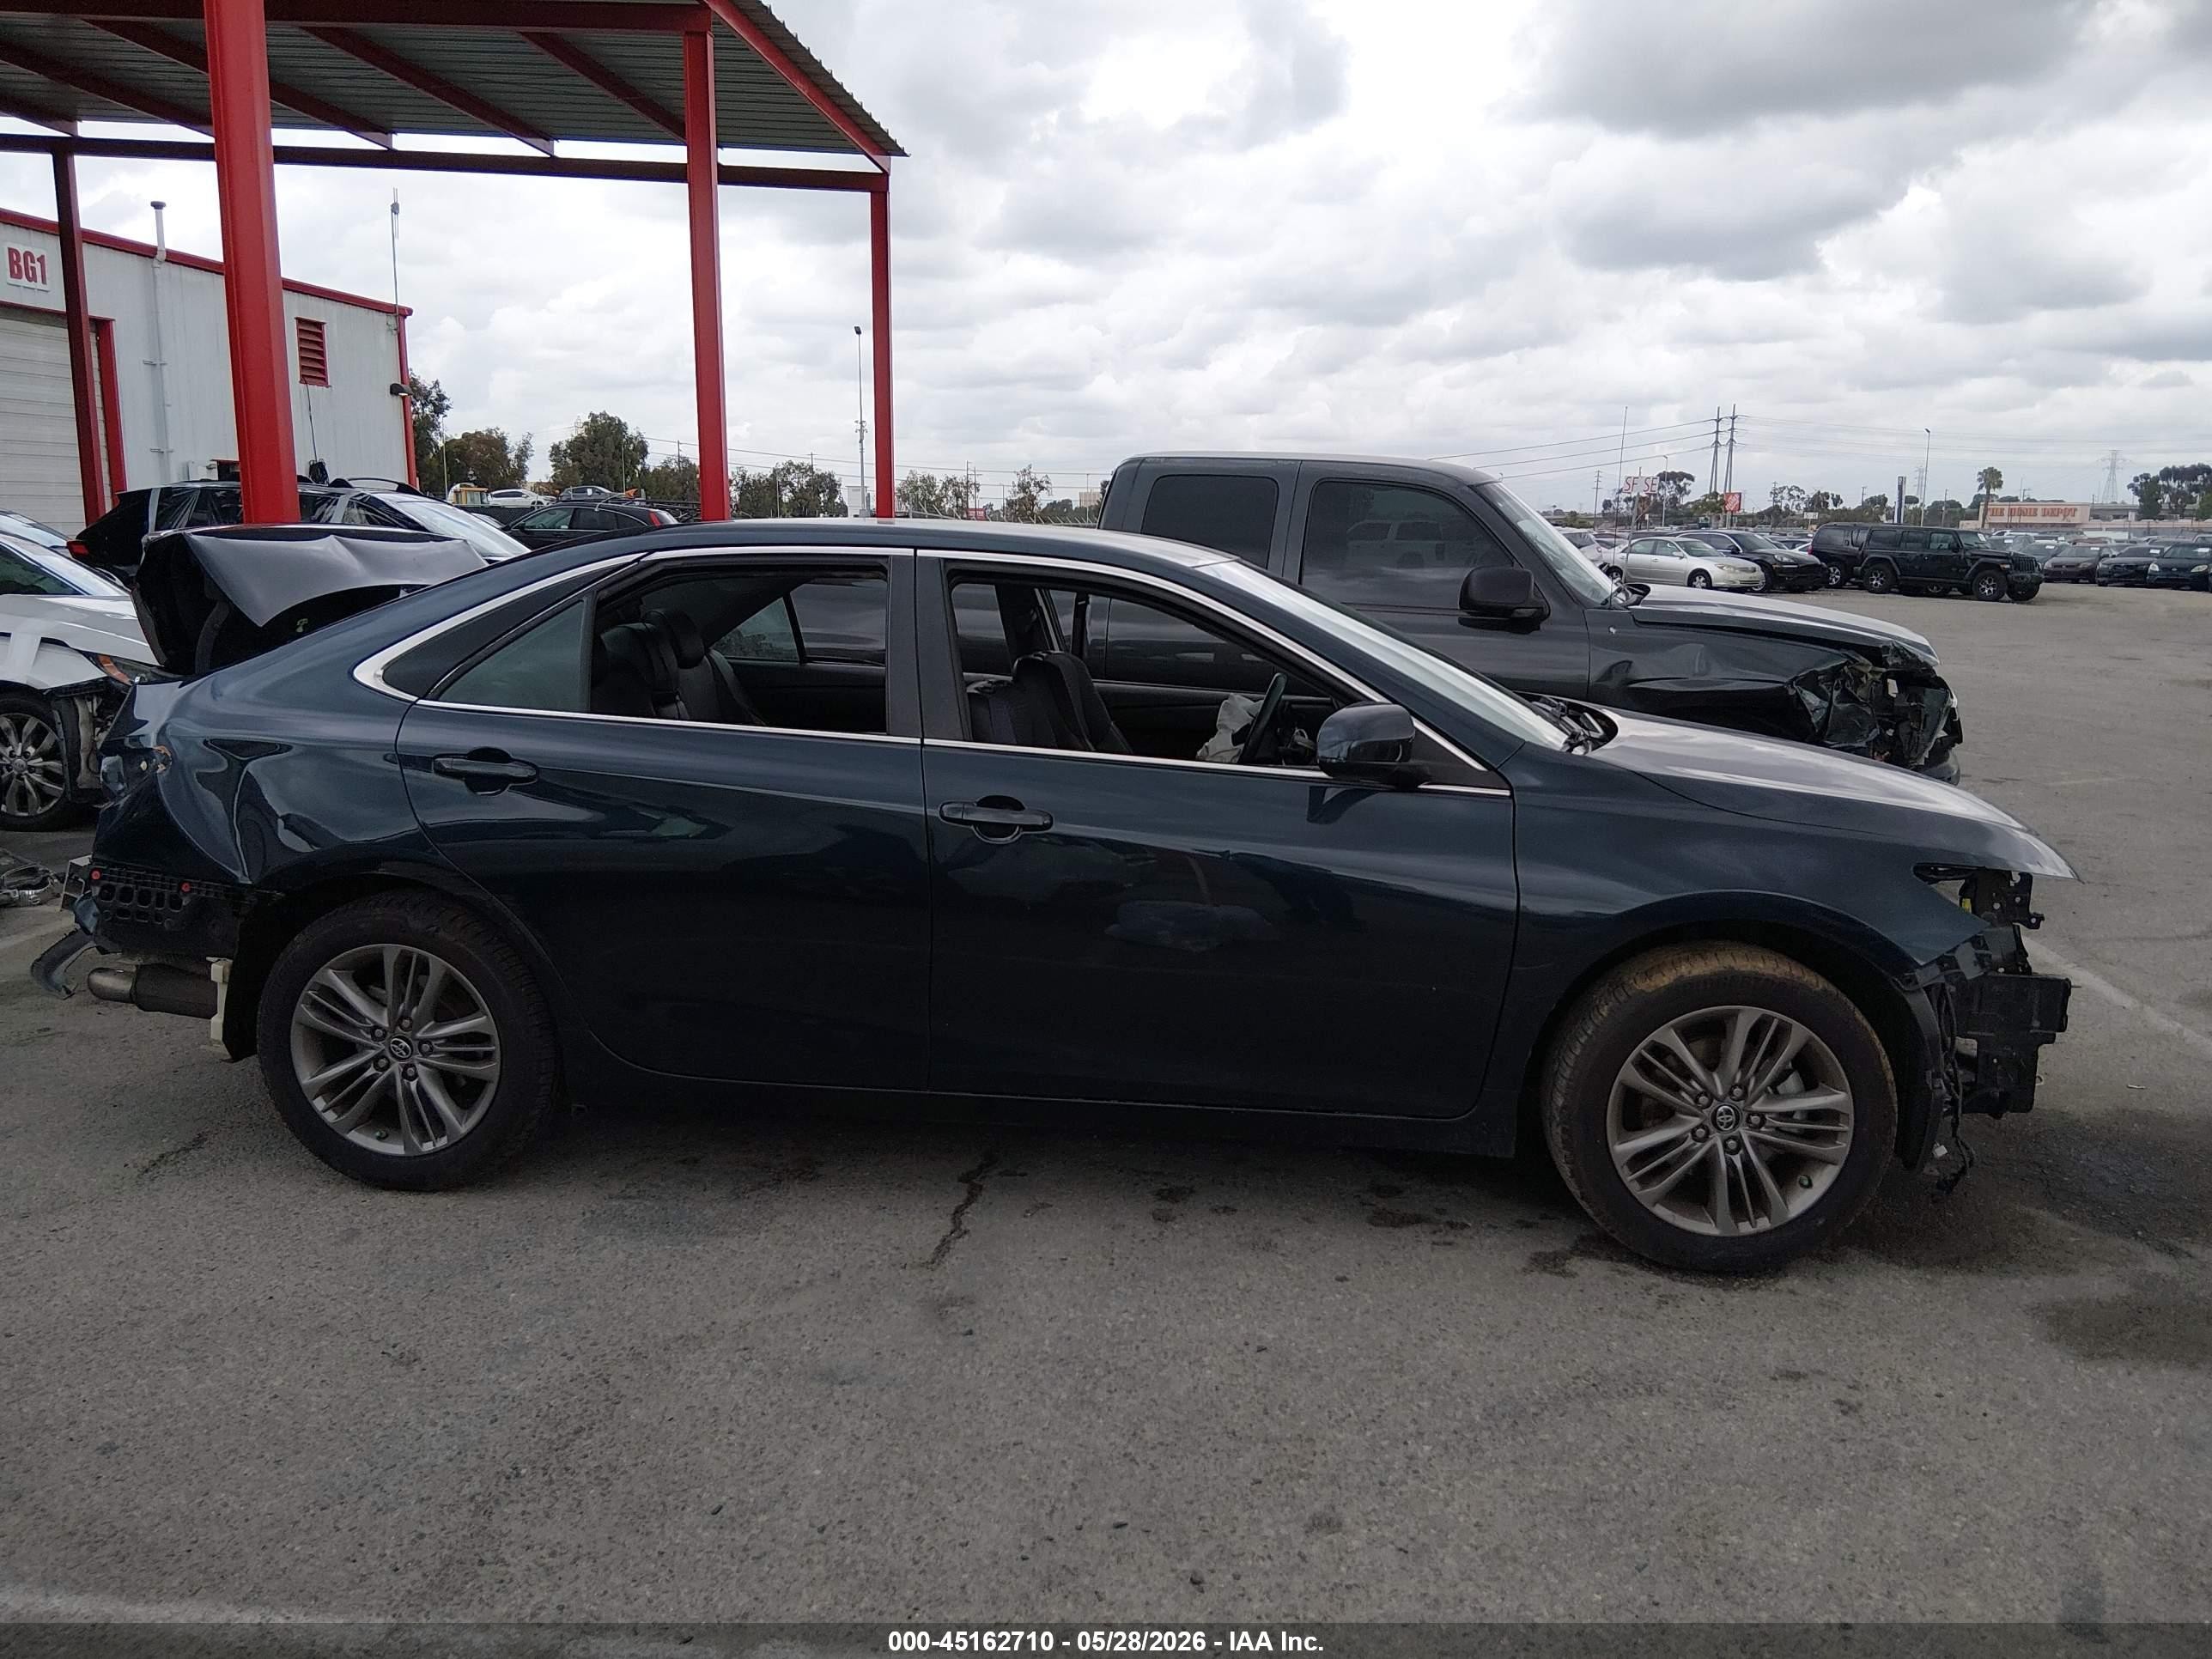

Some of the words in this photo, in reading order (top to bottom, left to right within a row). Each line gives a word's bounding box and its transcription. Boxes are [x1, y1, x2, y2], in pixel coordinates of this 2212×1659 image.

[8, 247, 47, 285] BG1
[1623, 477, 1639, 492] SF
[1644, 477, 1658, 492] SE
[2042, 507, 2076, 517] DEPOT
